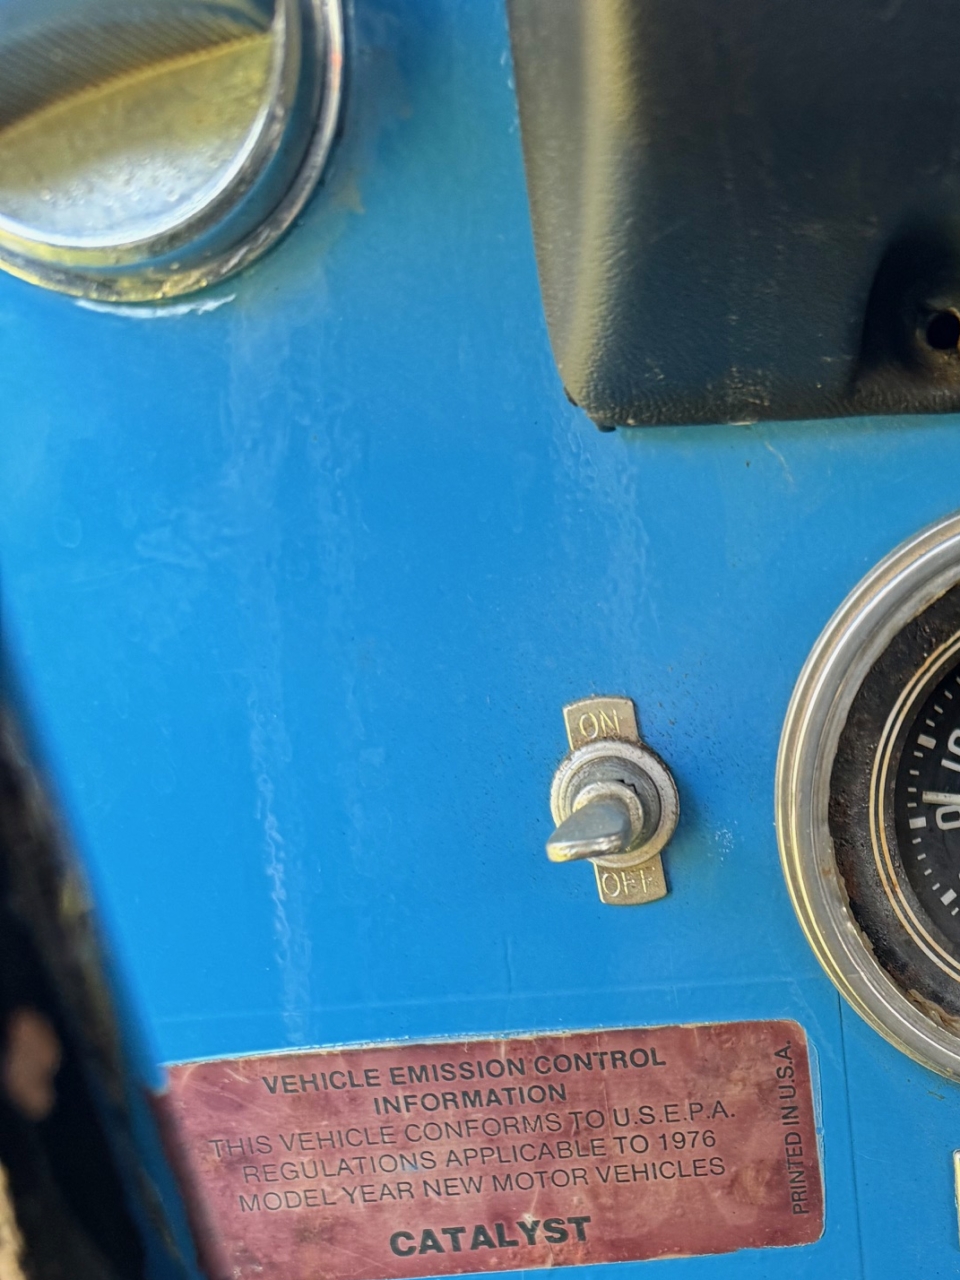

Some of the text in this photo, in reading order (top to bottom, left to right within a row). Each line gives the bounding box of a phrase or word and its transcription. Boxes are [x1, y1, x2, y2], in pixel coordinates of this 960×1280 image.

[579, 708, 621, 738] ON
[602, 869, 653, 896] OFF
[262, 1047, 667, 1095] VEHICLE EMISSION CONTROL
[373, 1083, 567, 1115] INFORMATION
[209, 1136, 273, 1158] THIS
[279, 1126, 397, 1152] VEHICLE
[405, 1112, 562, 1142] CONFORMS
[569, 1109, 605, 1130] TO
[774, 1040, 810, 1215] PRINTED IN U.S.A.
[243, 1130, 716, 1183] REGULATIONS APPLICABLE TO 1976
[239, 1157, 725, 1213] MODEL YEAR NEW MOTOR VEHICLES
[390, 1216, 591, 1257] CATALYST
